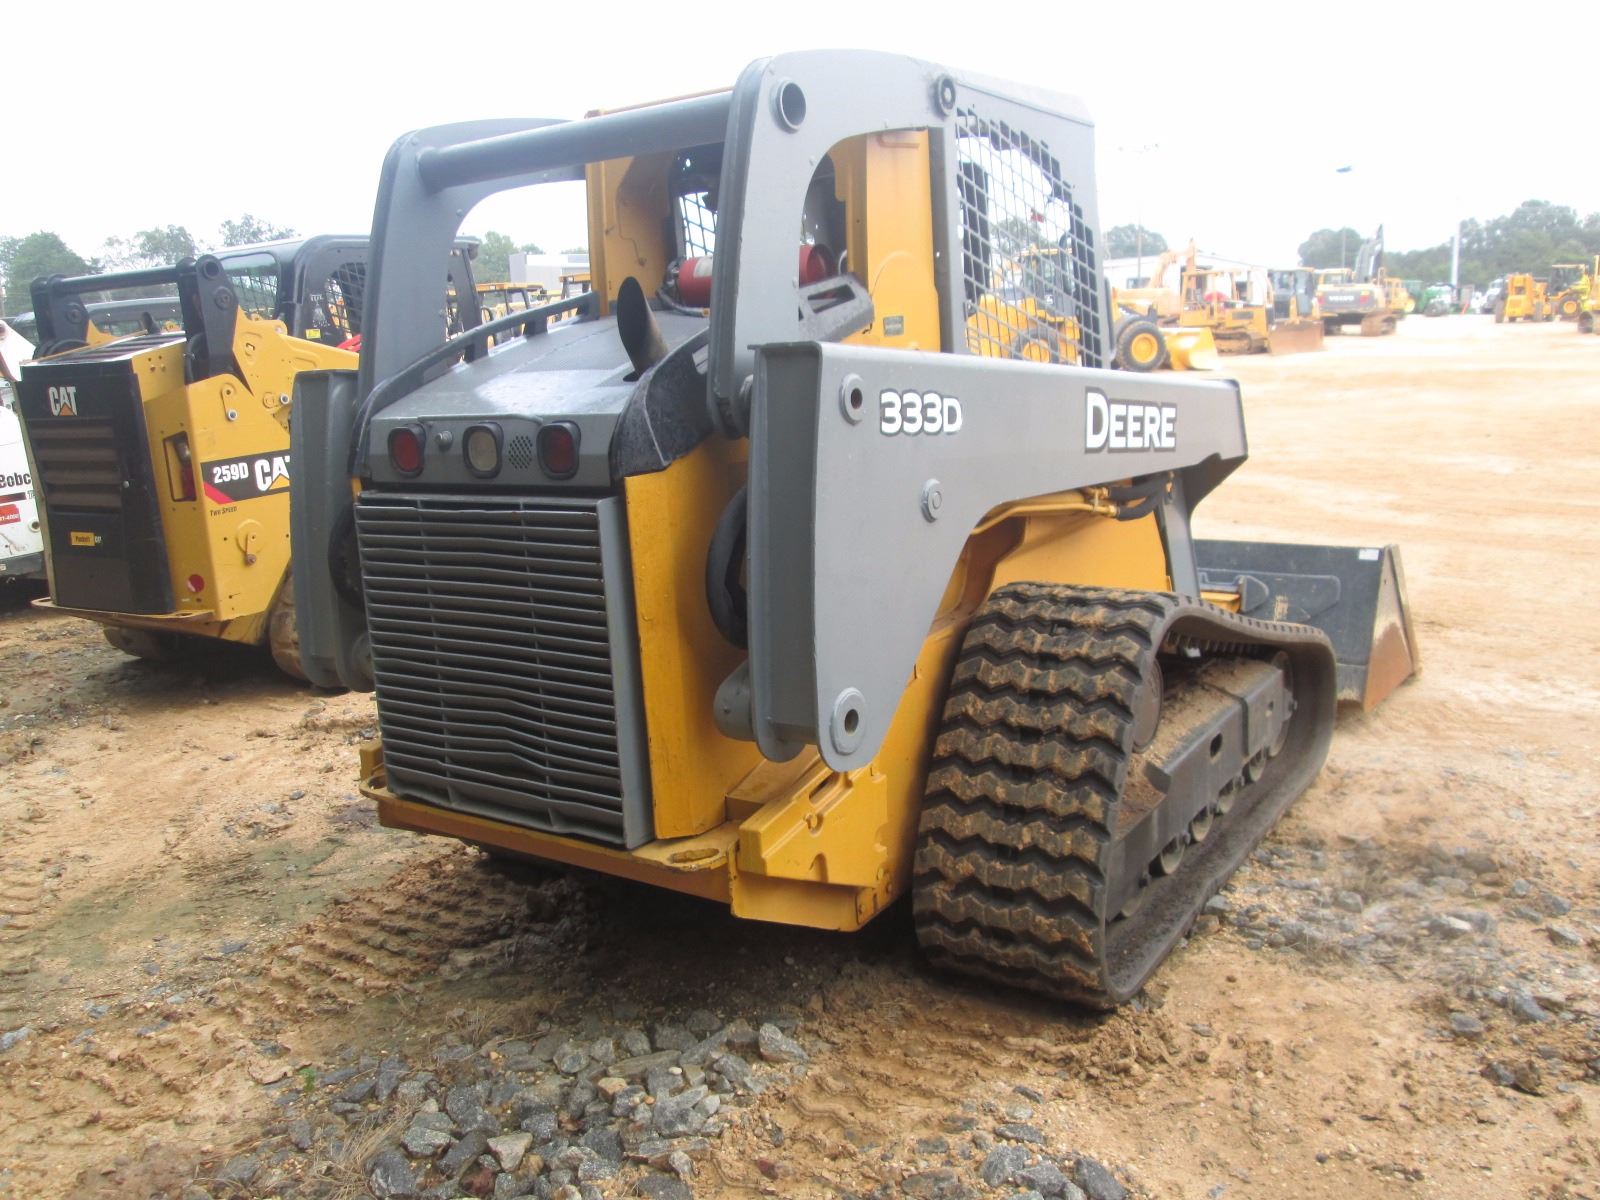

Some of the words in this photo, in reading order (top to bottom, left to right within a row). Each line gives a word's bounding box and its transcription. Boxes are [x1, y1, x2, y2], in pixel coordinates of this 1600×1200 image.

[48, 386, 77, 416] CAT
[880, 391, 962, 433] 333D
[1085, 390, 1177, 449] DEERE
[0, 472, 31, 488] Bobc
[213, 462, 249, 484] 259D
